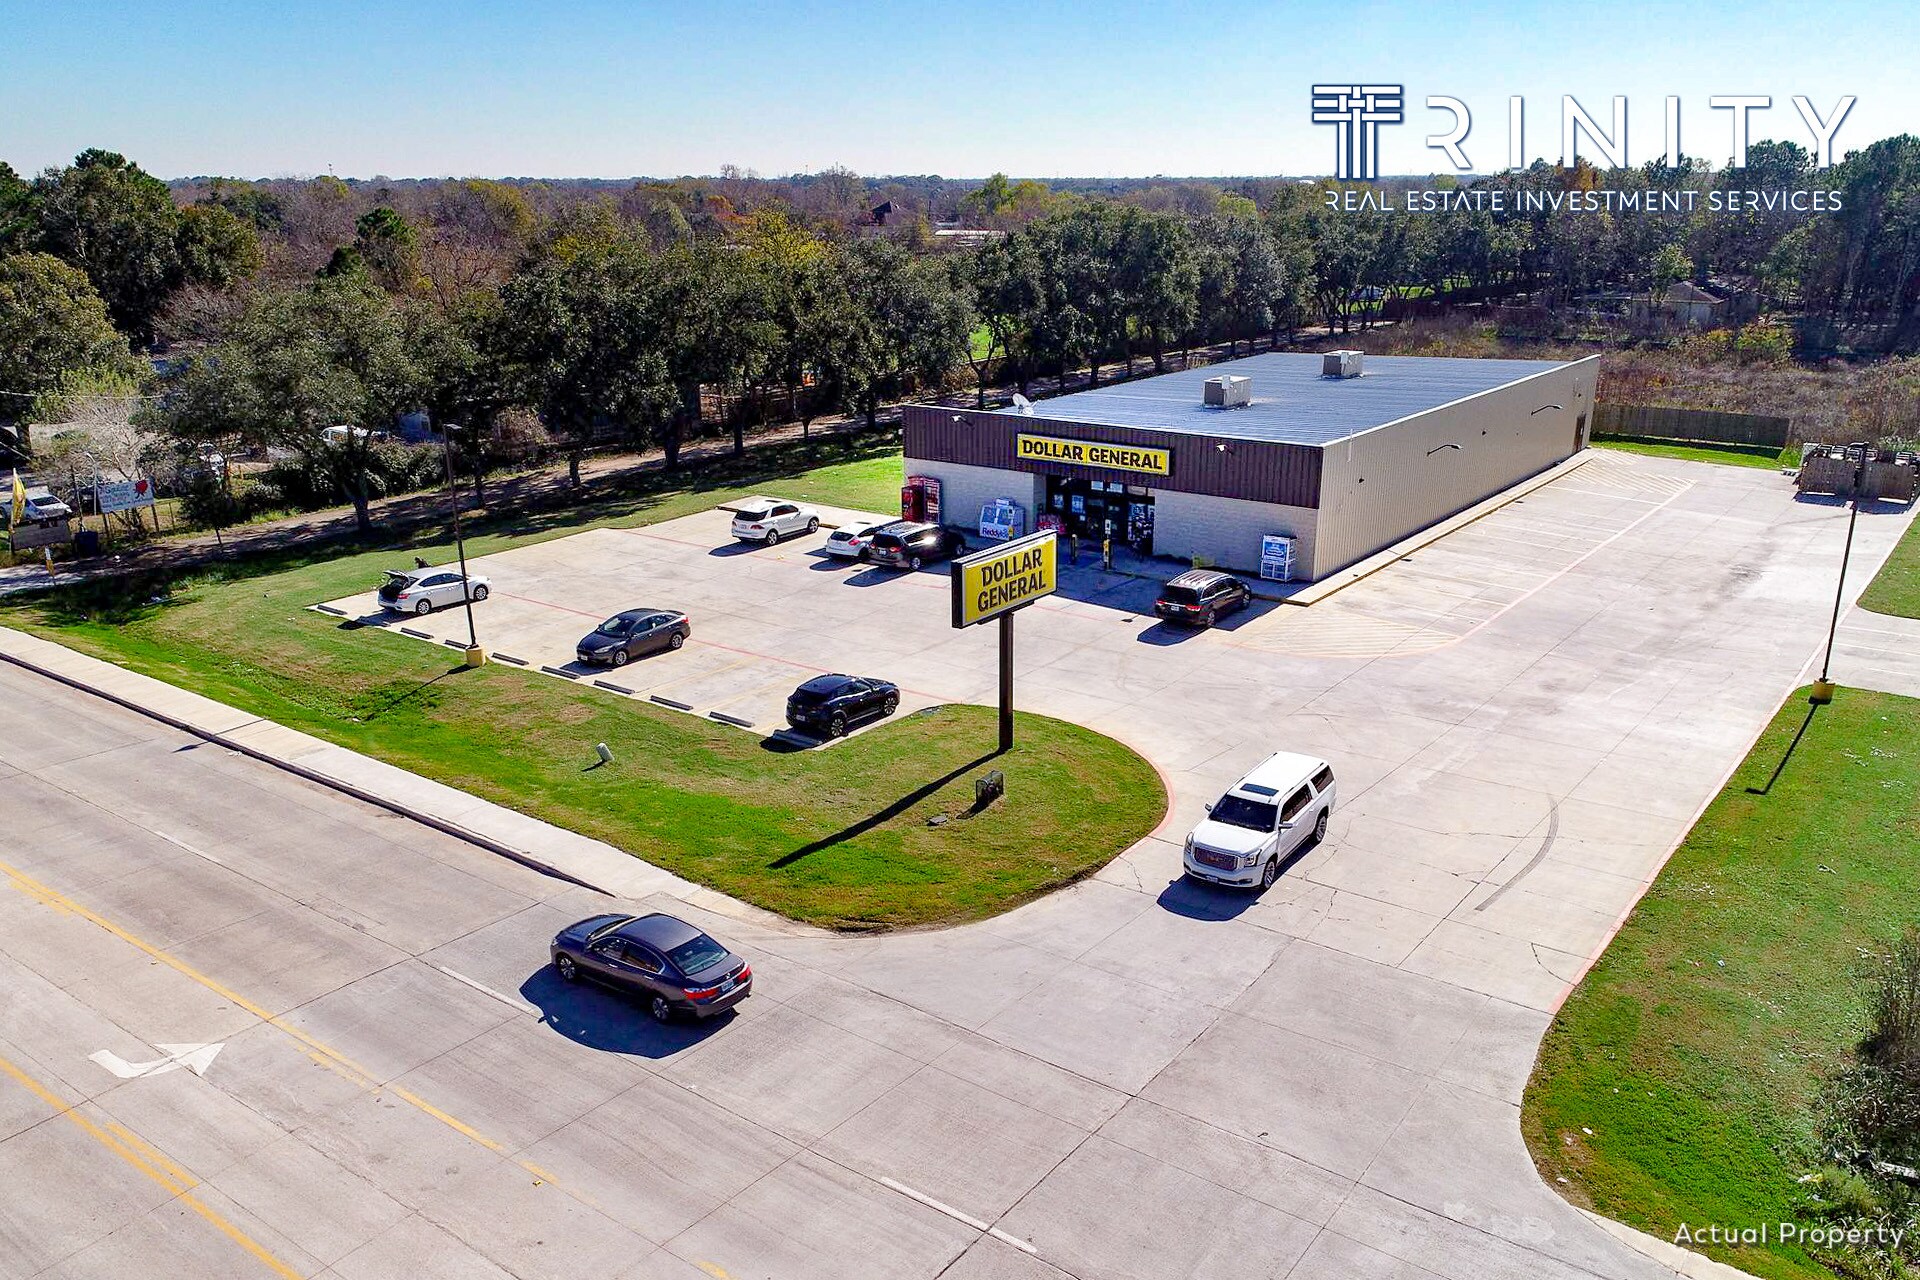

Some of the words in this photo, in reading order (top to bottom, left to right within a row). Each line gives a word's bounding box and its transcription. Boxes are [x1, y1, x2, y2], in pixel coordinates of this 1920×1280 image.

[1022, 439, 1083, 461] DOLLAR
[1089, 447, 1162, 470] GENERAL
[981, 548, 1043, 587] DOLLAR
[977, 570, 1047, 613] GENERAL
